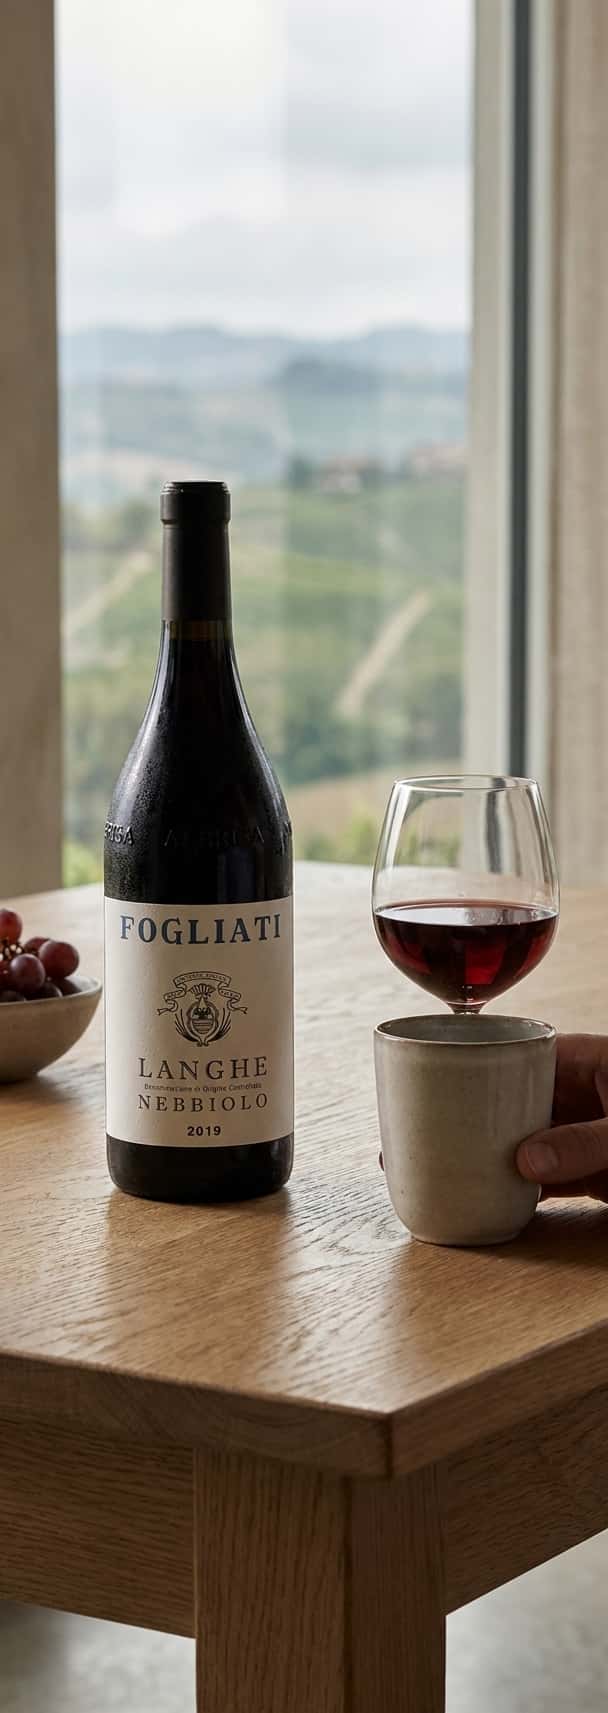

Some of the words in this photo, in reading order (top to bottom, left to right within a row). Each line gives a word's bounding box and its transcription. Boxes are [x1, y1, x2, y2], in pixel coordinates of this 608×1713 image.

[119, 913, 281, 945] FOGLIATI
[138, 1056, 268, 1080] LANGHE
[137, 1093, 268, 1112] NEBBIOLO
[187, 1126, 222, 1137] 2019
